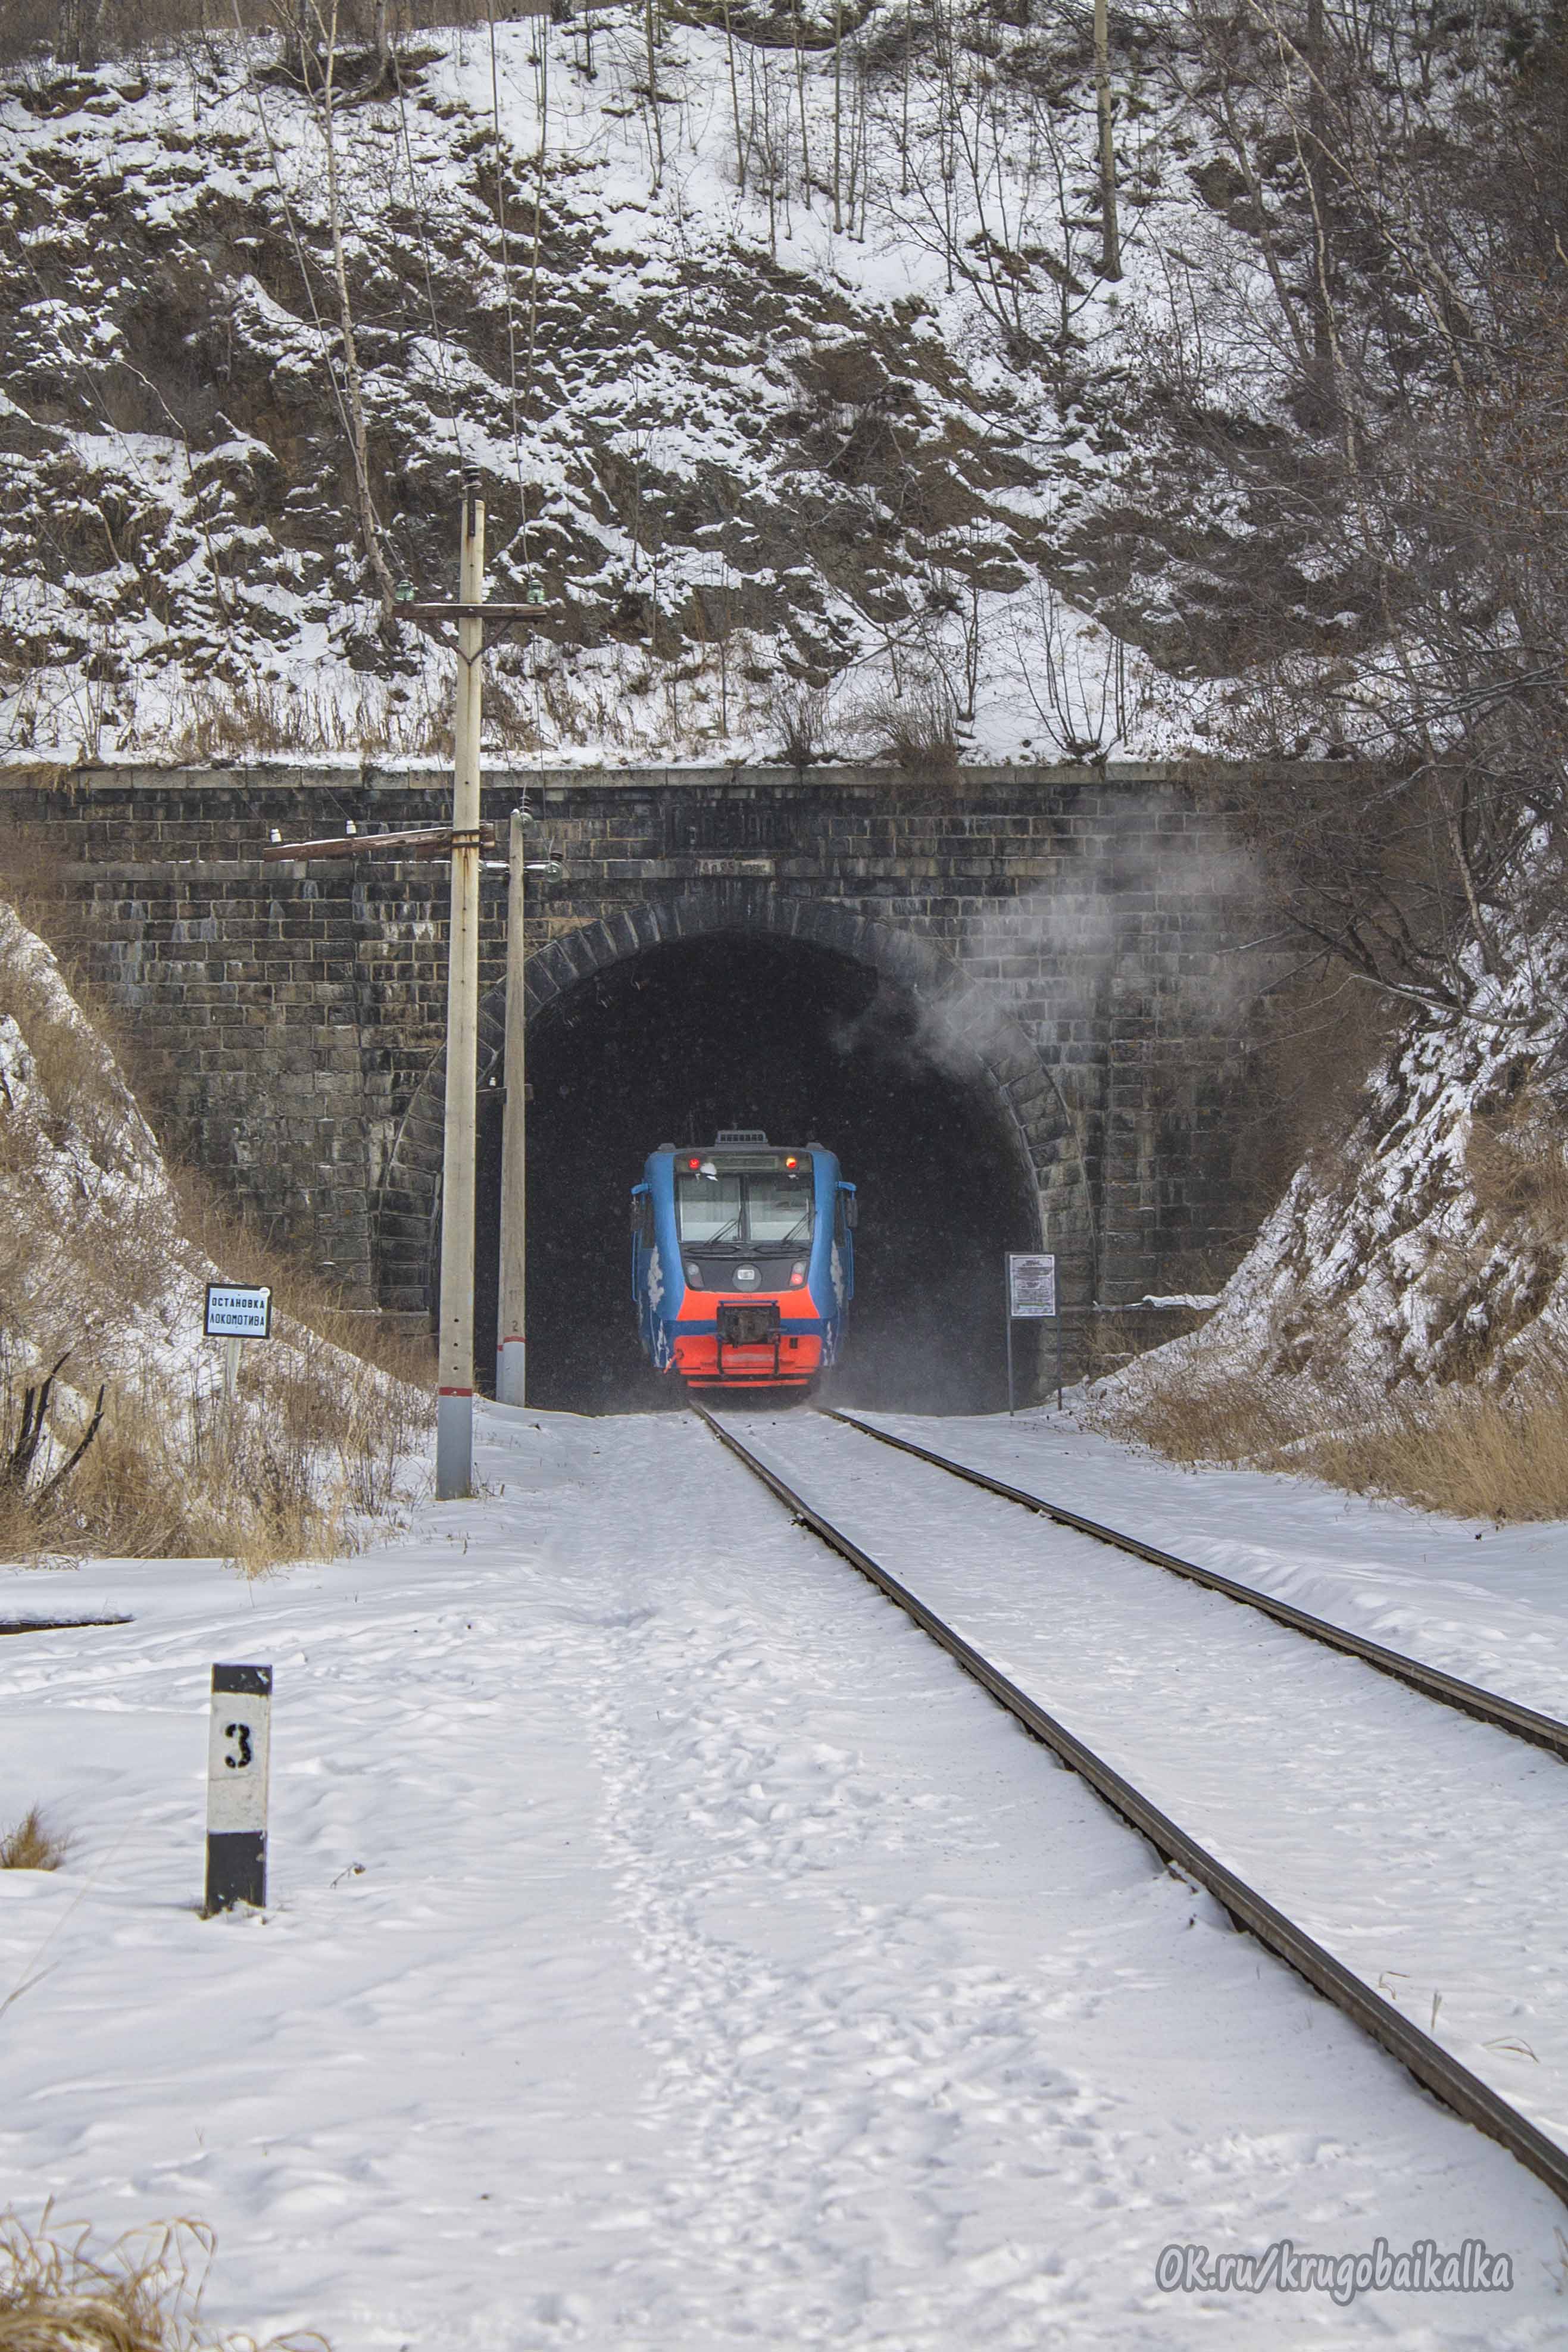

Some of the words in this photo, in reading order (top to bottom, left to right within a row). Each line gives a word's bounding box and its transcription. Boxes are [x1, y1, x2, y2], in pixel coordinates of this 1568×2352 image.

[211, 1297, 264, 1308] ОСТАНОВКА
[210, 1313, 264, 1326] ЛОКОМОТИВА
[512, 1320, 518, 1332] 2
[224, 1723, 252, 1769] 3
